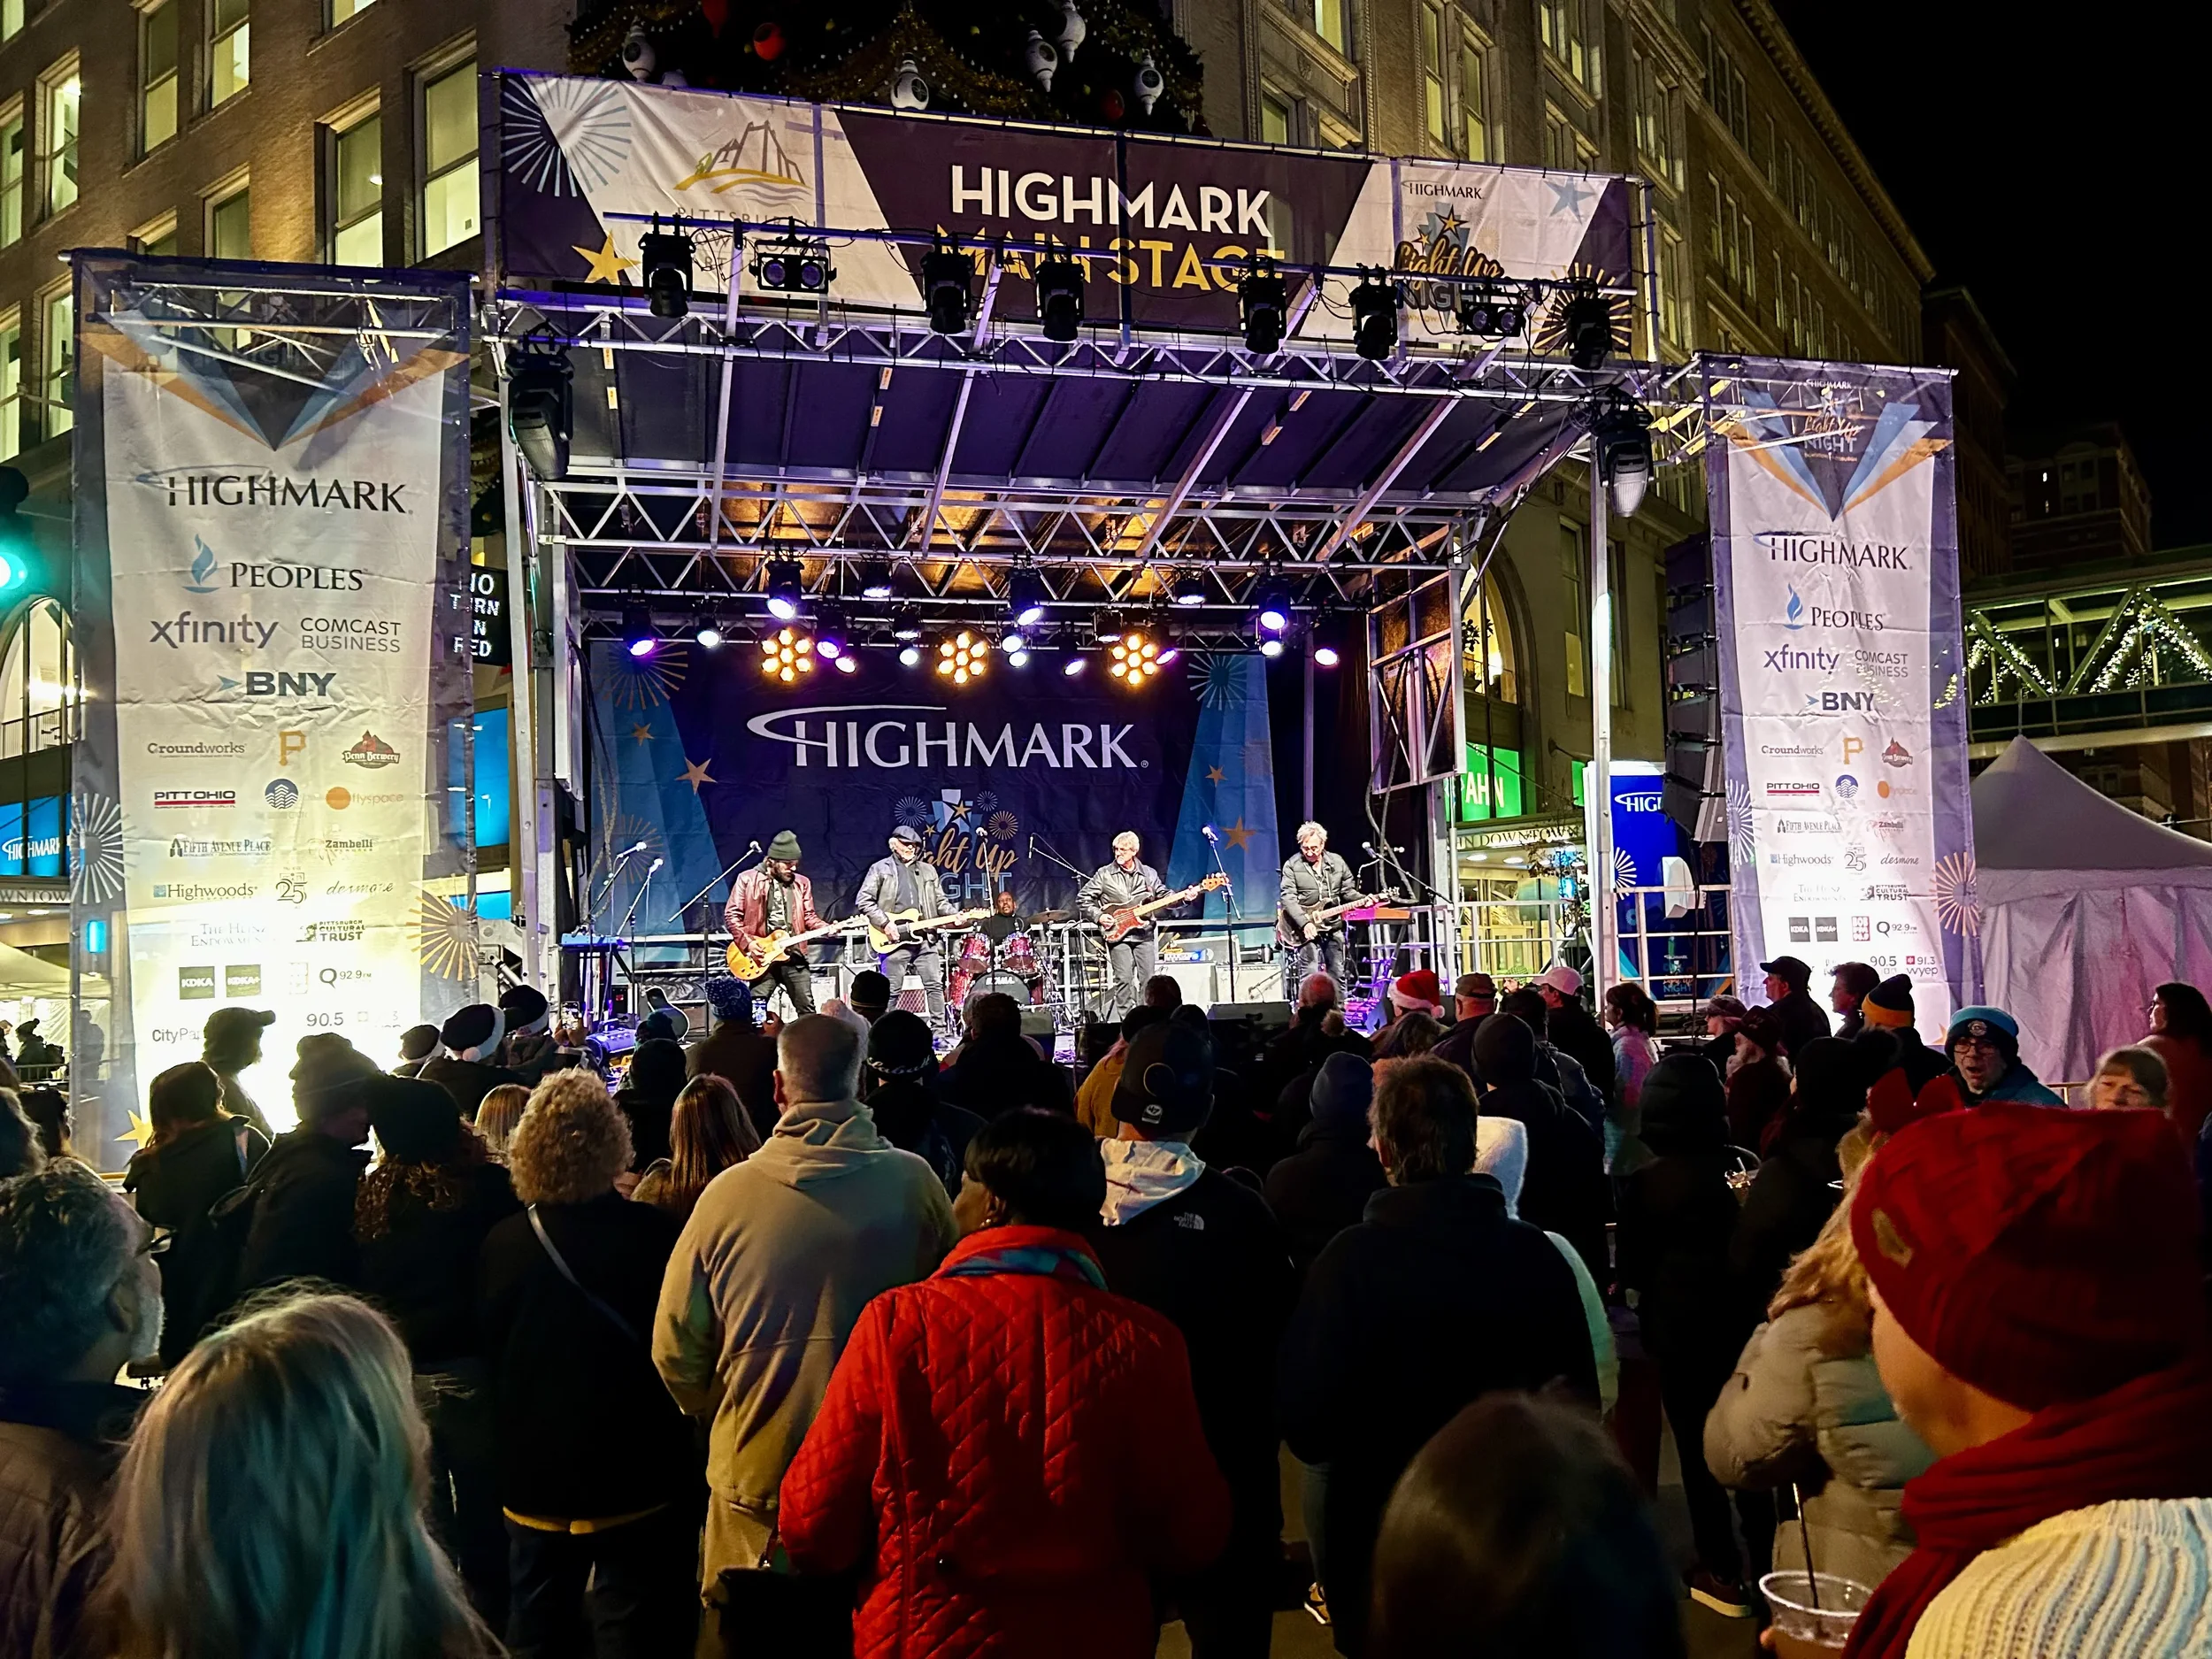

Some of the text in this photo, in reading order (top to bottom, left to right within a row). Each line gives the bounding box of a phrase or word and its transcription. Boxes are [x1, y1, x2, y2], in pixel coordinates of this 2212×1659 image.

[1409, 182, 1483, 200] HIGHMARK
[952, 165, 1272, 237] HIGHMARK
[678, 206, 816, 228] PITTSBUR
[1804, 434, 1858, 453] NIGHT
[166, 474, 407, 514] HIGHMARK
[1770, 536, 1909, 571] HIGHMARK
[230, 561, 364, 592] PEOPLES
[449, 593, 501, 617] TRN
[301, 617, 402, 636] COMCAST
[1810, 606, 1884, 631] PEOPLES
[150, 611, 280, 649] xfinity
[301, 634, 401, 653] BUSINESS
[1763, 643, 1840, 675] xfinity
[1855, 649, 1909, 664] COMCAST
[245, 672, 337, 697] BNY
[1822, 691, 1875, 711] BNY
[787, 715, 1139, 769] HIGHMARK
[154, 790, 236, 800] PITT OHIO
[351, 793, 404, 806] flyspace
[1465, 771, 1504, 809] AHN
[325, 839, 373, 849] Zambelli
[975, 841, 1019, 883] Up
[1778, 853, 1832, 867] Highwoods
[1844, 851, 1868, 872] 25
[1880, 852, 1919, 865] desmone
[167, 882, 254, 901] Highwoods
[275, 878, 308, 904] 25
[938, 872, 1013, 900] GHT
[0, 890, 68, 902] WNTOW
[319, 931, 364, 942] TRUST
[1877, 921, 1890, 938] Q
[1870, 956, 1897, 967] 90.5
[1916, 956, 1936, 965] 91.3
[319, 967, 338, 989] Q
[339, 970, 363, 980] 929
[1906, 967, 1939, 977] wyep
[180, 977, 215, 988] KDKA
[305, 1011, 344, 1027] 90.5
